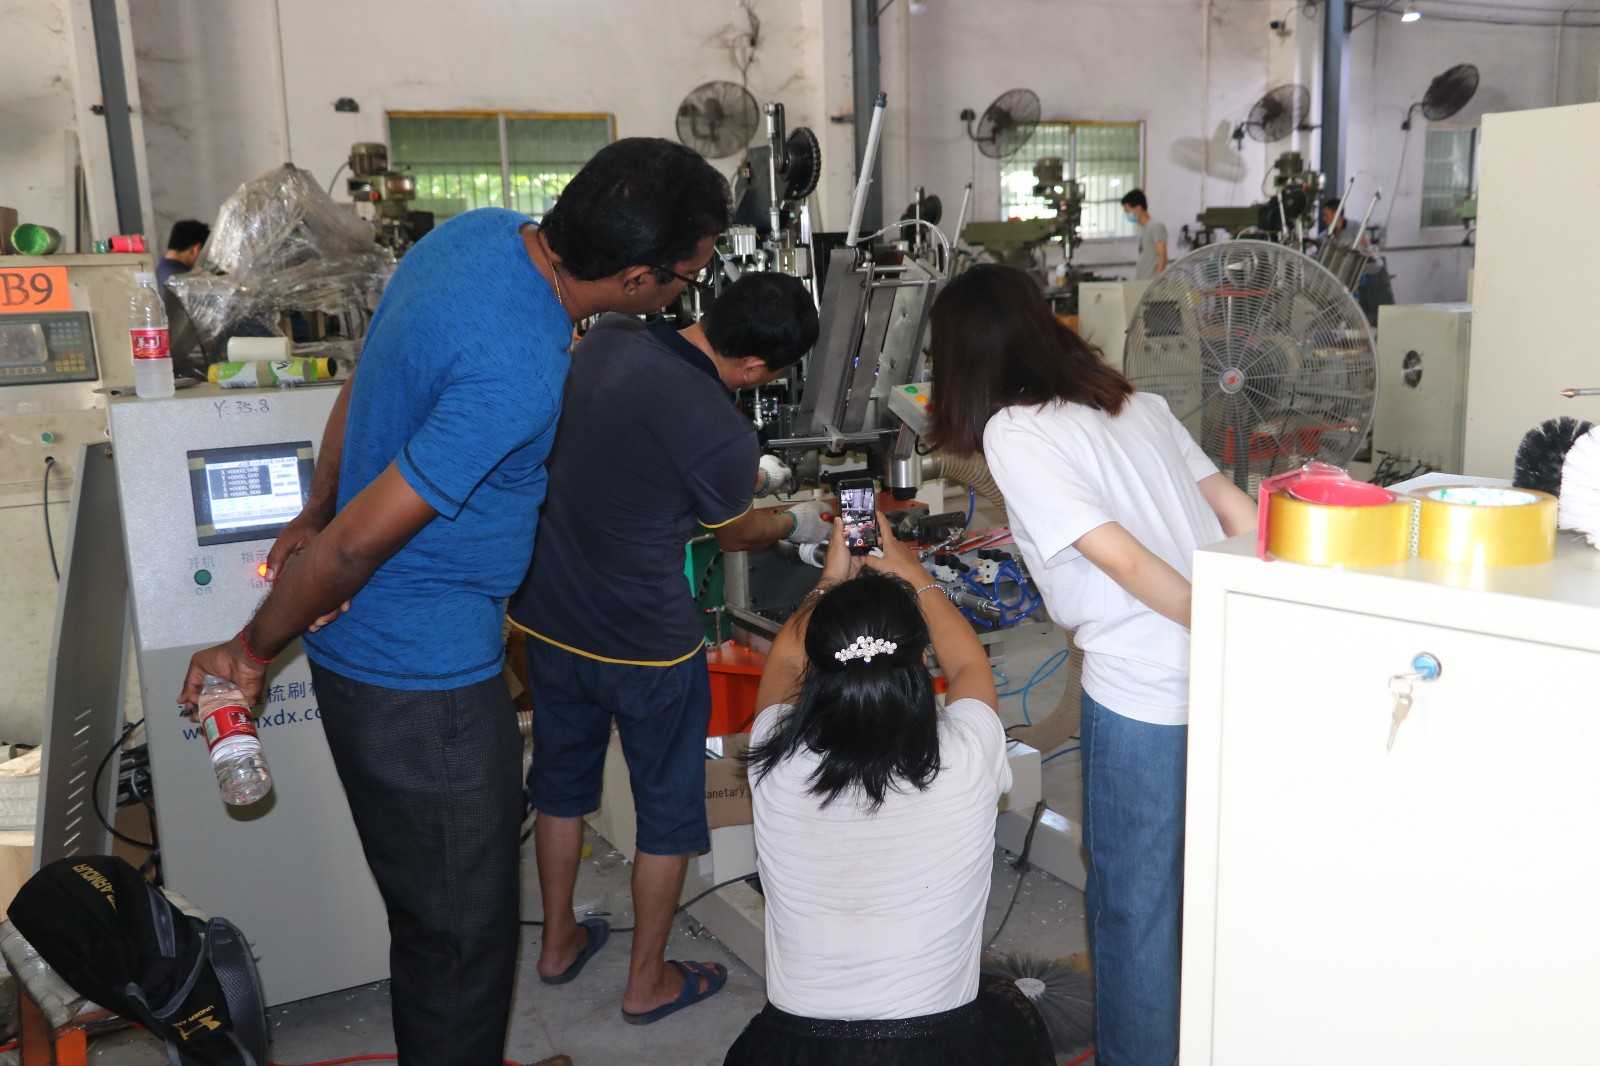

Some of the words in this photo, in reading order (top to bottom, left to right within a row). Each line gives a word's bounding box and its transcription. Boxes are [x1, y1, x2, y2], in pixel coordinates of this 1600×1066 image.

[0, 272, 53, 306] B9
[188, 554, 216, 570] 开机
[704, 787, 745, 799] anetary
